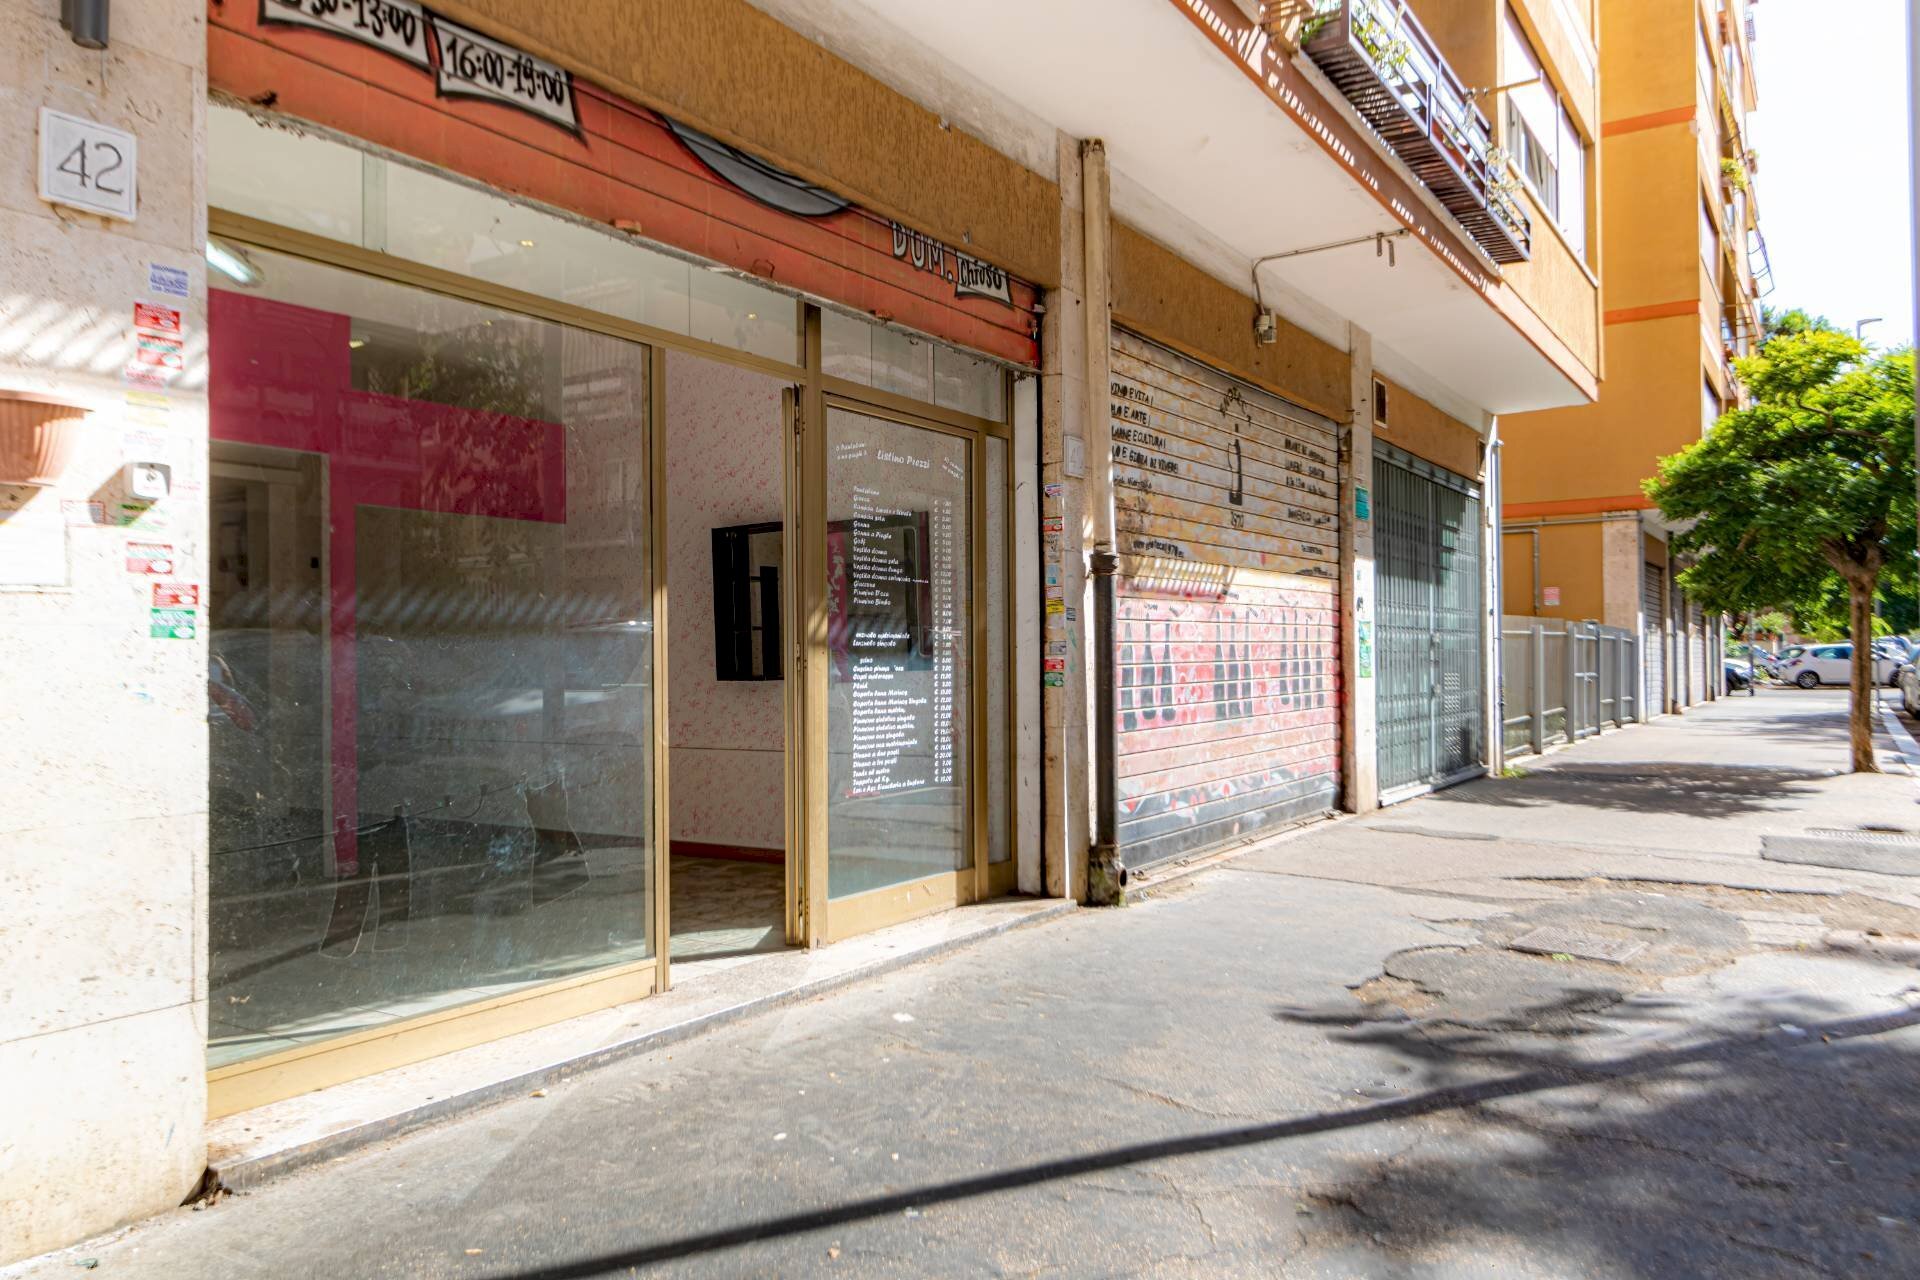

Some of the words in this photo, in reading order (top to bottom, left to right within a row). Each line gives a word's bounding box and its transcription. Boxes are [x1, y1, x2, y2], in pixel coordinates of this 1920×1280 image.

[446, 36, 566, 106] 16:00-19:00
[57, 138, 124, 196] 42
[877, 449, 904, 465] Listino
[905, 455, 931, 470] Prezzi
